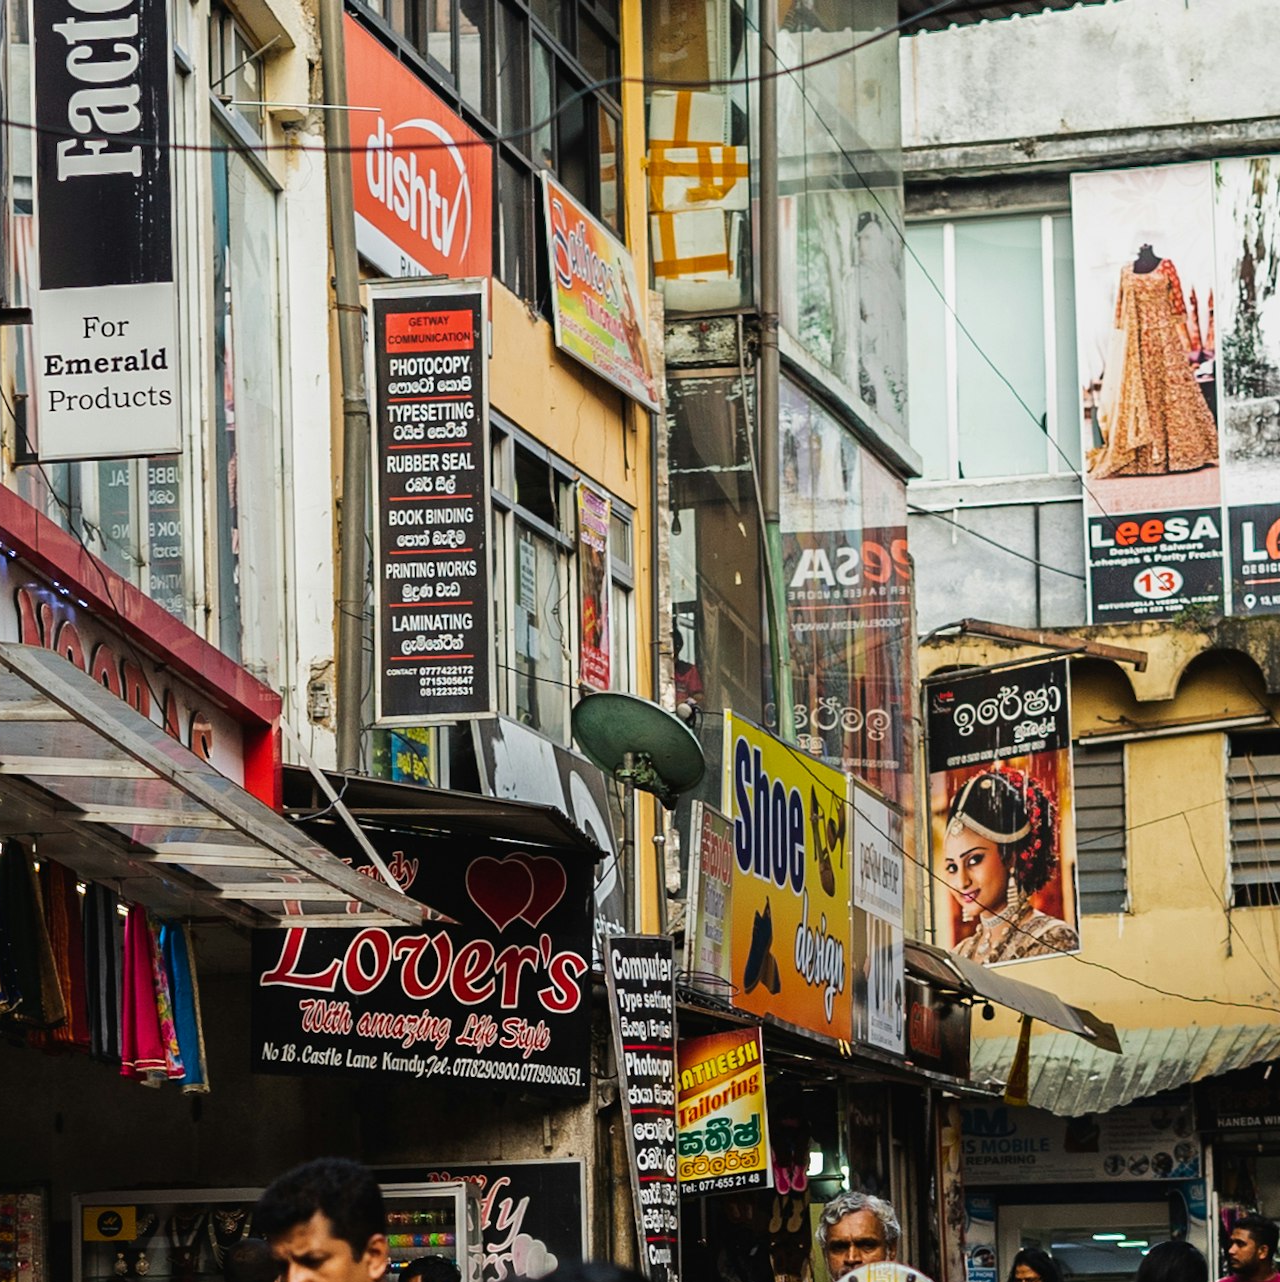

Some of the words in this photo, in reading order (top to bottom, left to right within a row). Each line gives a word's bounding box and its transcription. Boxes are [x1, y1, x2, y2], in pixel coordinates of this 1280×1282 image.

[366, 116, 470, 258] dishtv
[82, 317, 129, 339] For
[408, 315, 450, 327] GETWAY
[388, 332, 470, 345] COMMUNICATION
[44, 348, 168, 377] Emerald
[390, 356, 470, 376] PHOTOCOPY
[49, 386, 172, 413] Products
[387, 402, 474, 423] TYPESETTING
[387, 455, 439, 473] RUBBER
[442, 453, 475, 471] SEAL
[389, 509, 423, 526] BOOK
[426, 507, 474, 524] BINDING
[385, 562, 435, 579] PRINTING
[437, 560, 477, 577] WORKS
[1139, 572, 1176, 593] 13
[392, 613, 473, 632] LAMINATING
[734, 735, 806, 896] Shoe
[260, 905, 589, 1014] Lover's
[795, 885, 846, 1024] design
[612, 950, 672, 987] Computer
[617, 988, 642, 1013] Type
[300, 998, 353, 1034] With
[357, 1009, 452, 1050] amazing
[456, 1014, 498, 1054] Life
[500, 1016, 551, 1060] Style
[262, 1041, 277, 1061] No
[346, 1048, 377, 1069] Lane
[678, 1071, 761, 1129] Tailoring
[1217, 1116, 1261, 1128] HANEDA
[981, 1137, 1051, 1153] MOBILE
[966, 1154, 1036, 1166] REPAIRING
[681, 1183, 697, 1194] Tel:
[699, 1178, 734, 1191] 077-655
[736, 1175, 746, 1186] 21
[748, 1173, 760, 1184] 48
